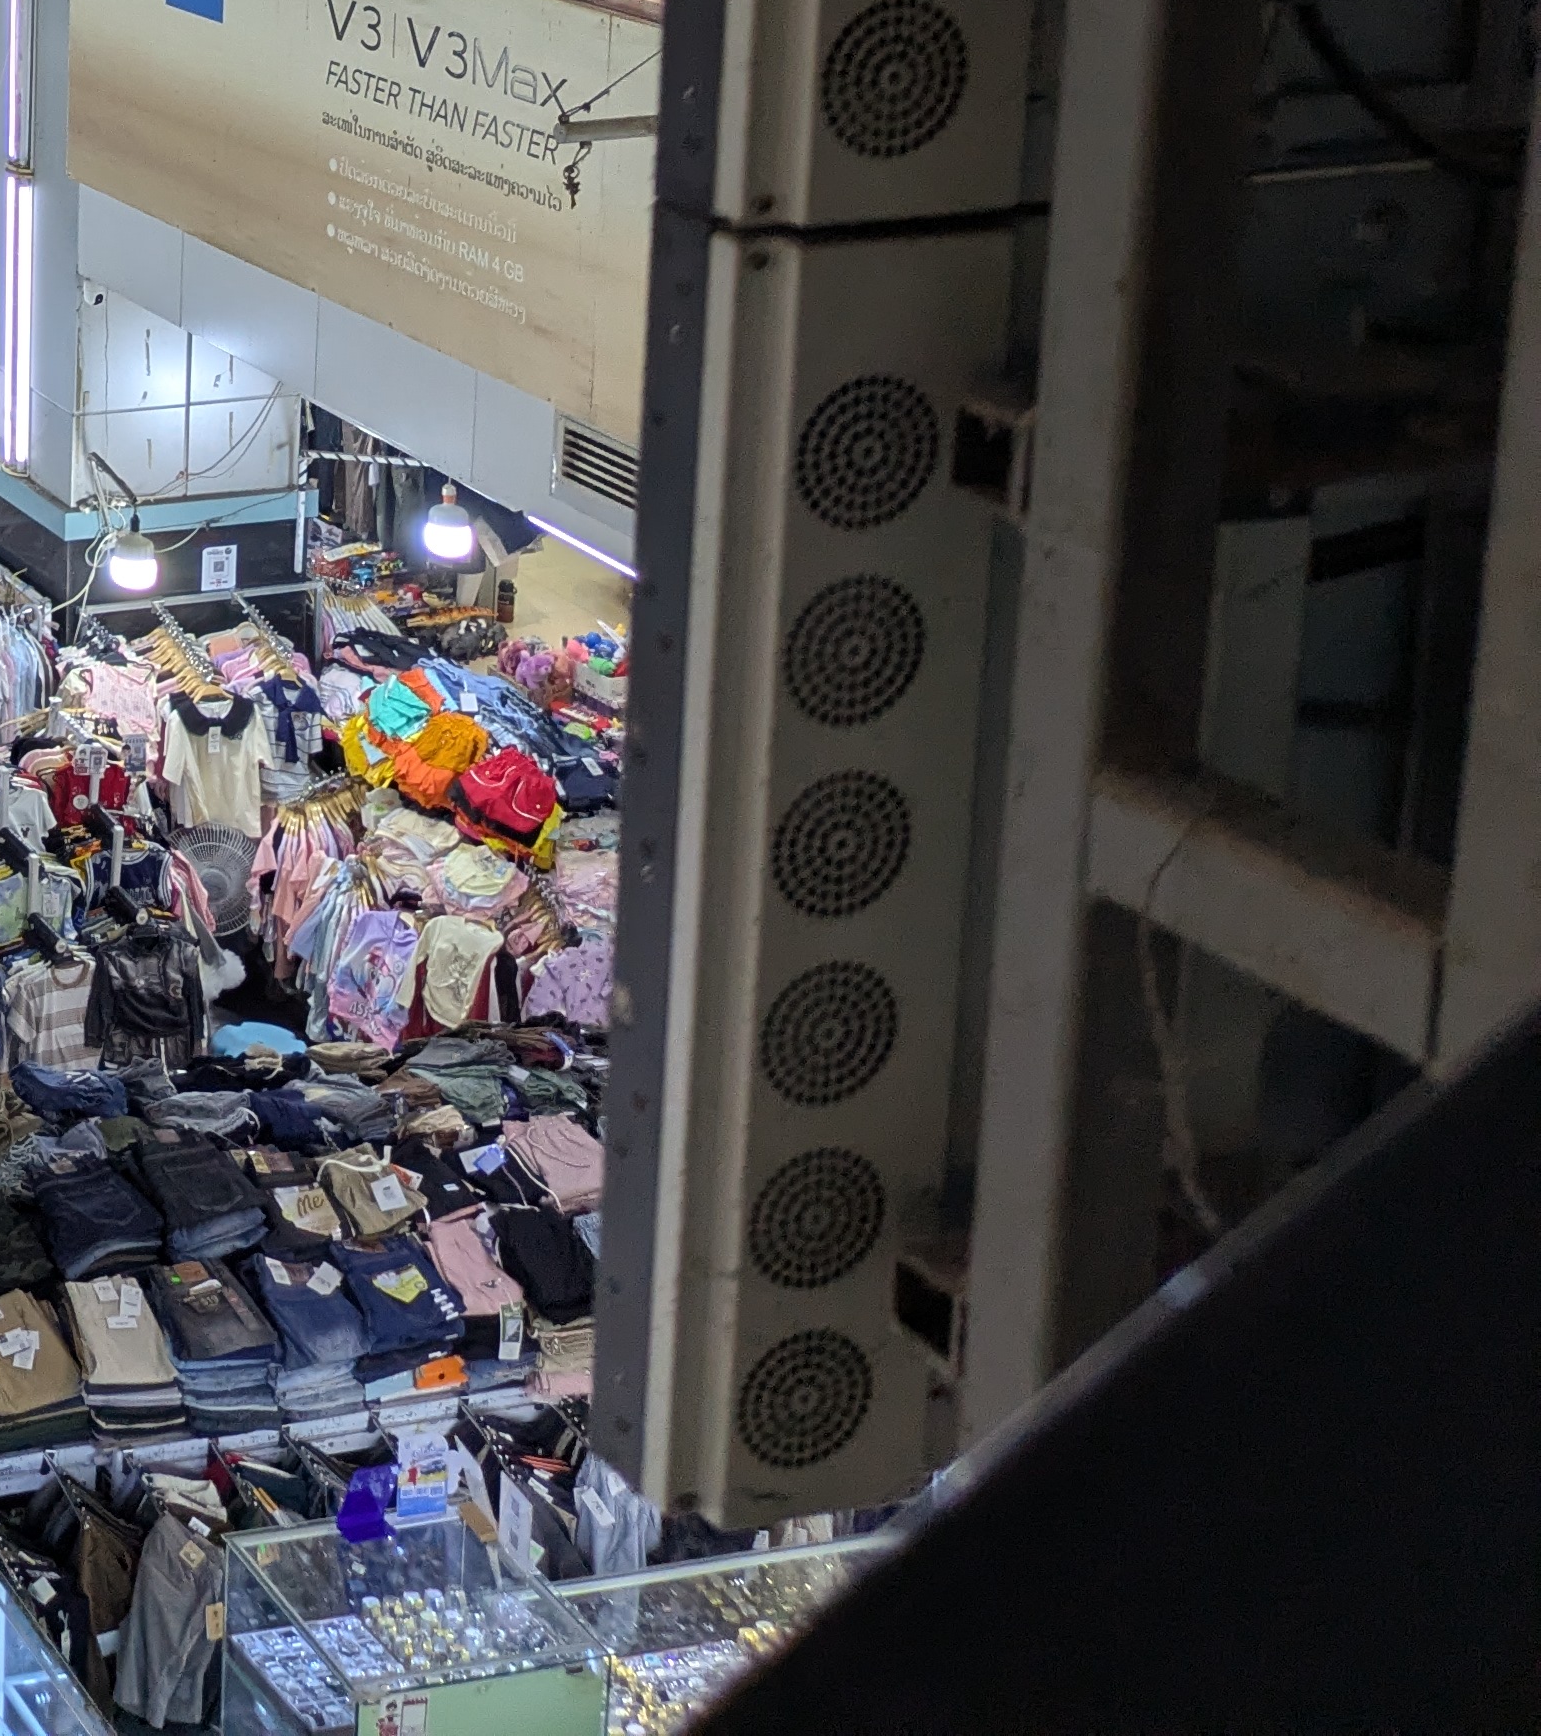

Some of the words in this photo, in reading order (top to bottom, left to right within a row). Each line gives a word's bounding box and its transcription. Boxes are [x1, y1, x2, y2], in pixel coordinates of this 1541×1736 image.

[325, 60, 402, 109] FASTER
[408, 86, 469, 133] THAN
[471, 108, 560, 165] FASTER
[406, 16, 568, 116] V3Max
[458, 241, 489, 271] RAM
[491, 255, 500, 273] 4
[504, 260, 524, 283] GB
